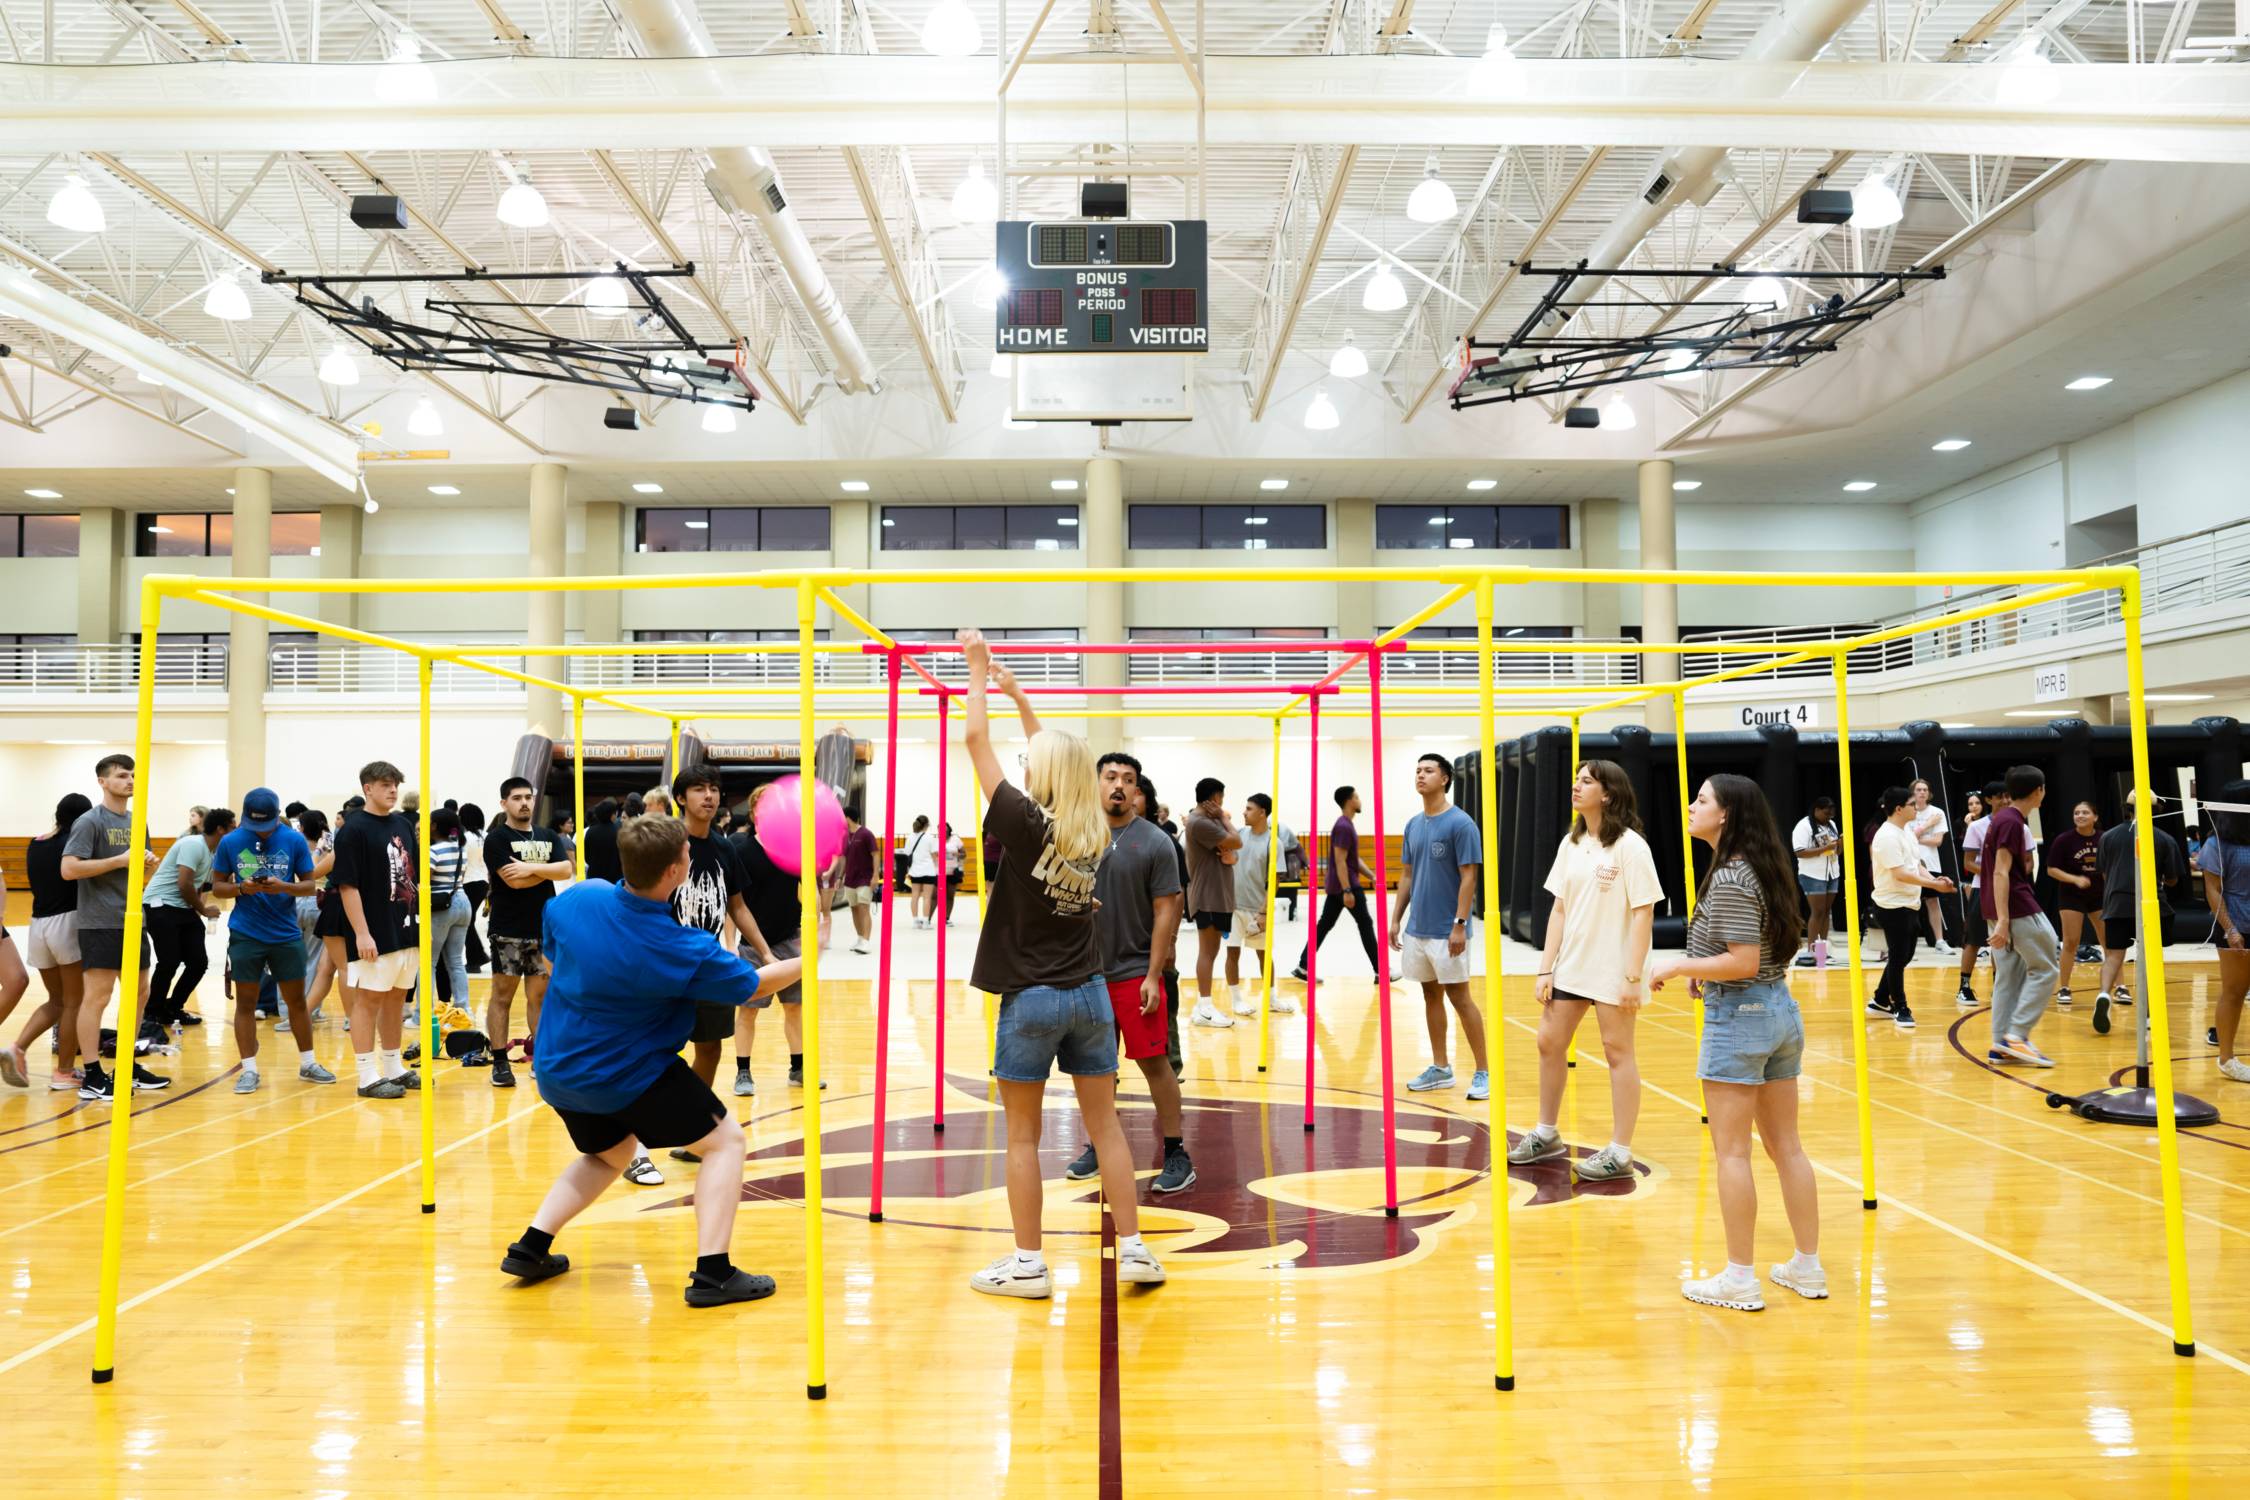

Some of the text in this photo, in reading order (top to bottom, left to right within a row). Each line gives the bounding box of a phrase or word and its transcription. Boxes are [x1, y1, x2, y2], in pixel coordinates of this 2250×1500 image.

[1076, 272, 1127, 285] BONUS
[1087, 287, 1116, 298] POSS
[1078, 298, 1126, 310] PERIOD
[999, 327, 1069, 345] HOME
[1129, 327, 1207, 344] VISITOR
[2036, 672, 2067, 696] MPR B
[1742, 705, 1808, 726] Court 4
